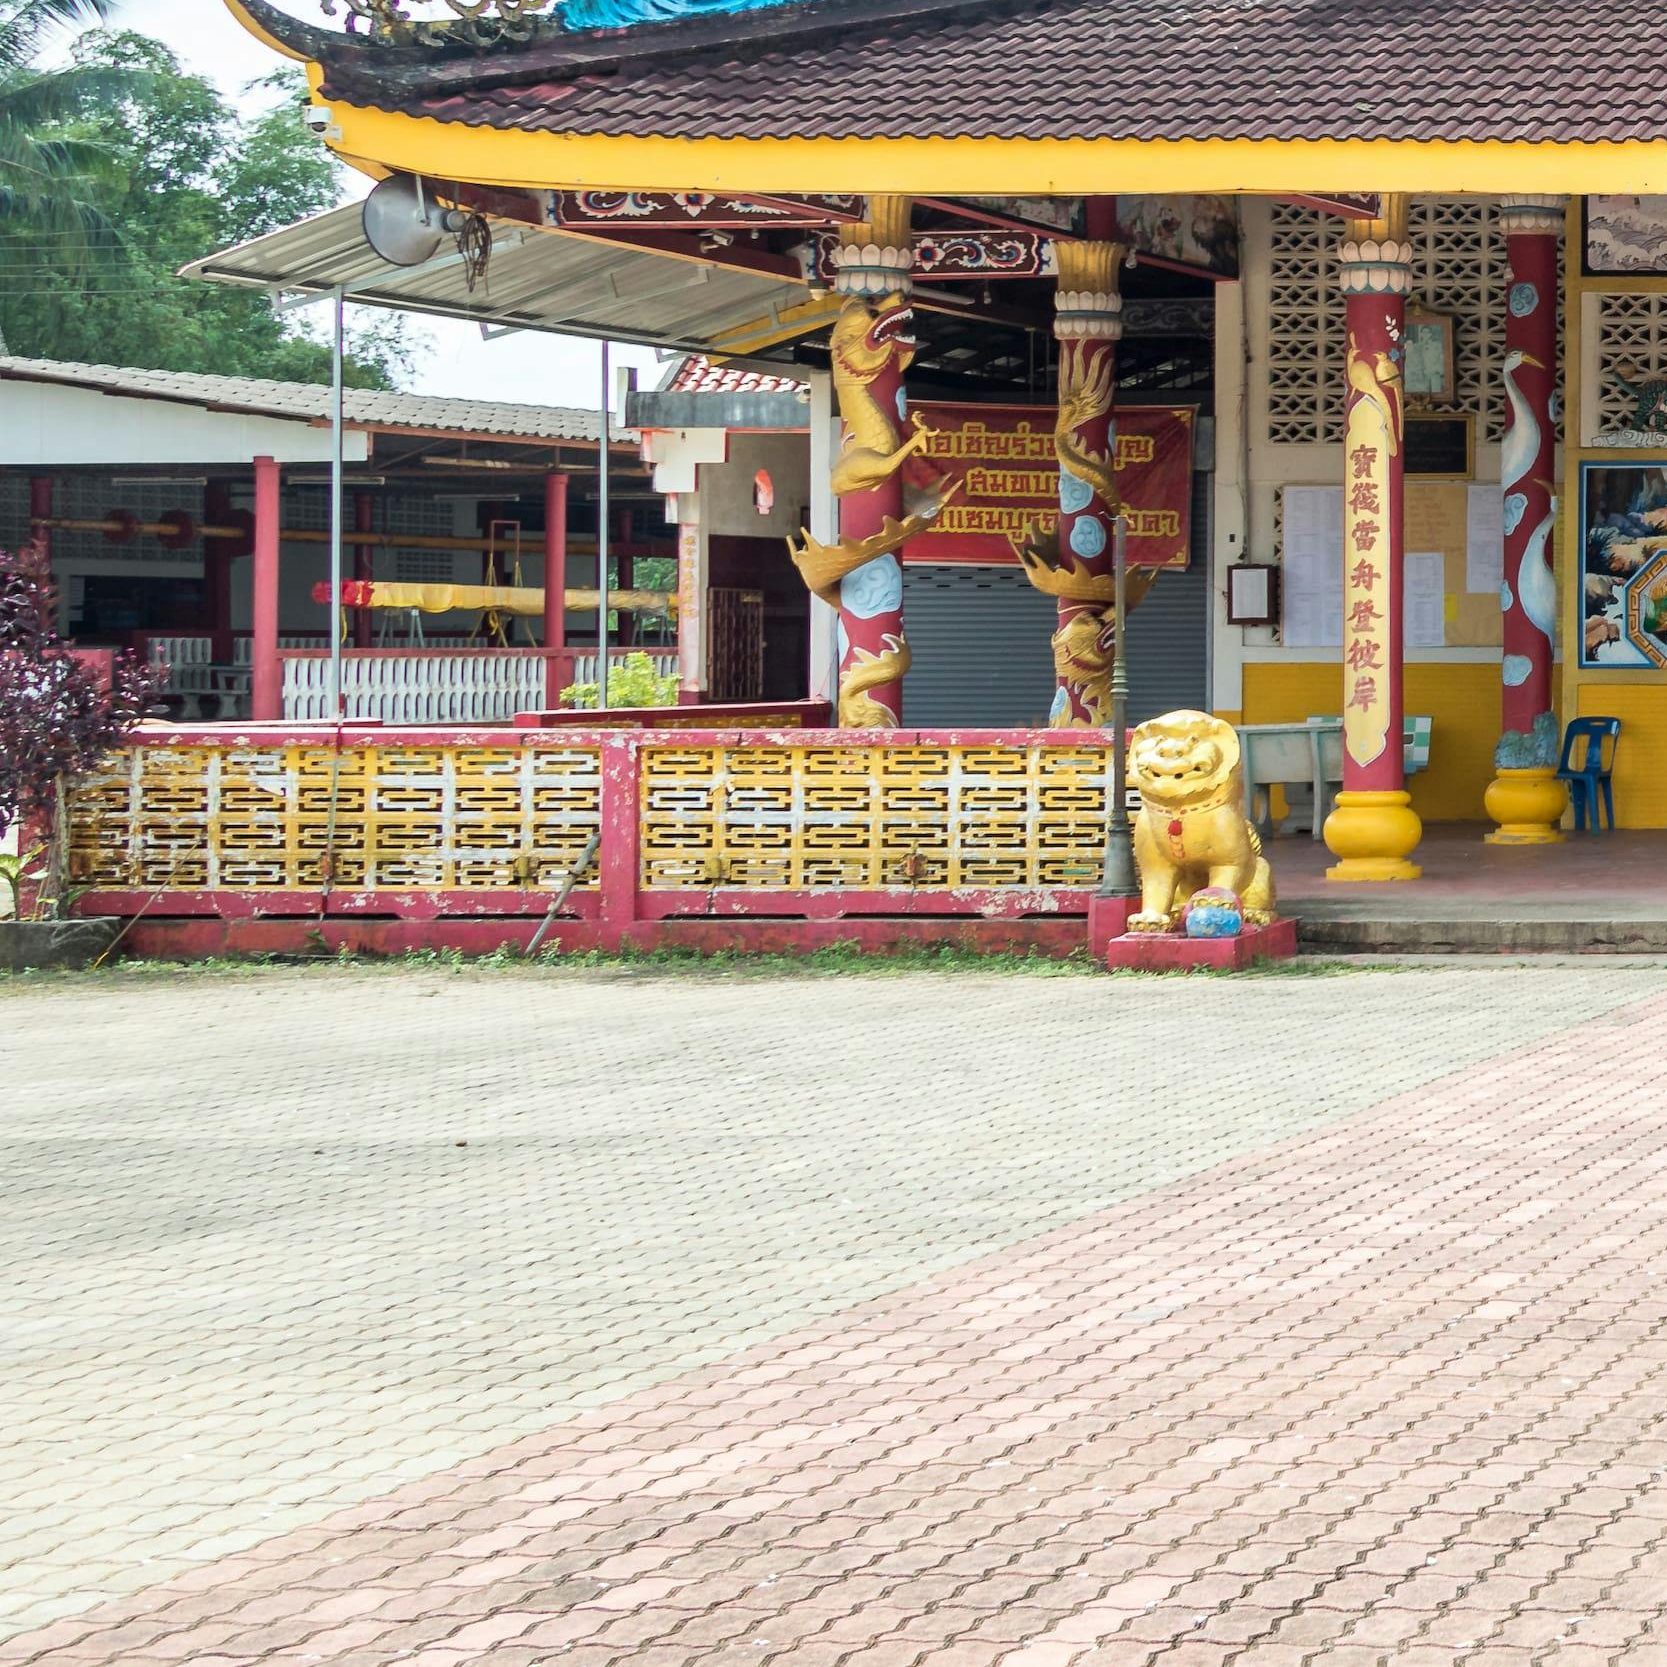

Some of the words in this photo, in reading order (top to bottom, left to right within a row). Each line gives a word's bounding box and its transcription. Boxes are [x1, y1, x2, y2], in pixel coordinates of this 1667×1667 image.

[1346, 444, 1384, 713] 寶筏當舟登彼岸
